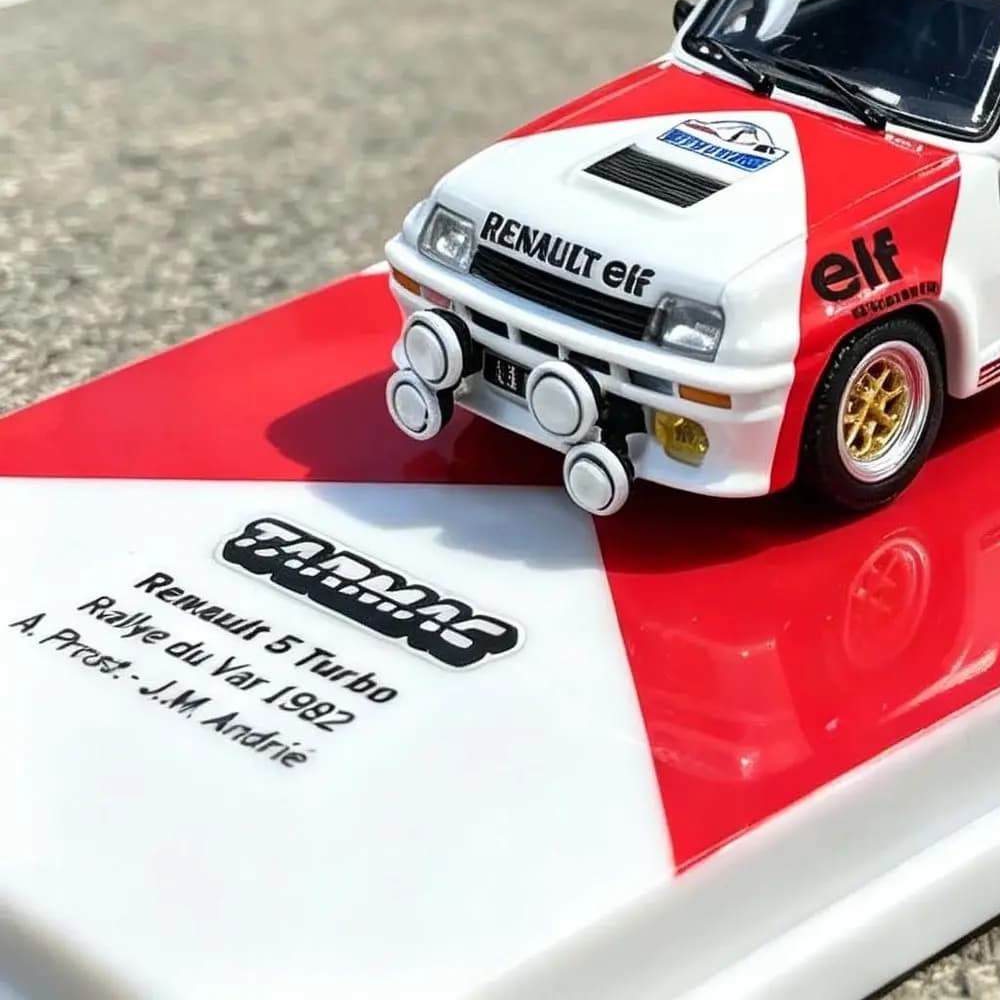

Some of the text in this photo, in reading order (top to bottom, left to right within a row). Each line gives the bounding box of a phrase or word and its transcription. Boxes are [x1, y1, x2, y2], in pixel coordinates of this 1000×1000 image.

[479, 211, 656, 297] RENAULT elf
[811, 226, 903, 302] elf
[8, 612, 46, 637] A.
[77, 596, 356, 732] Rallye du Var 1982
[264, 634, 304, 653] 5
[294, 647, 398, 703] Turbo
